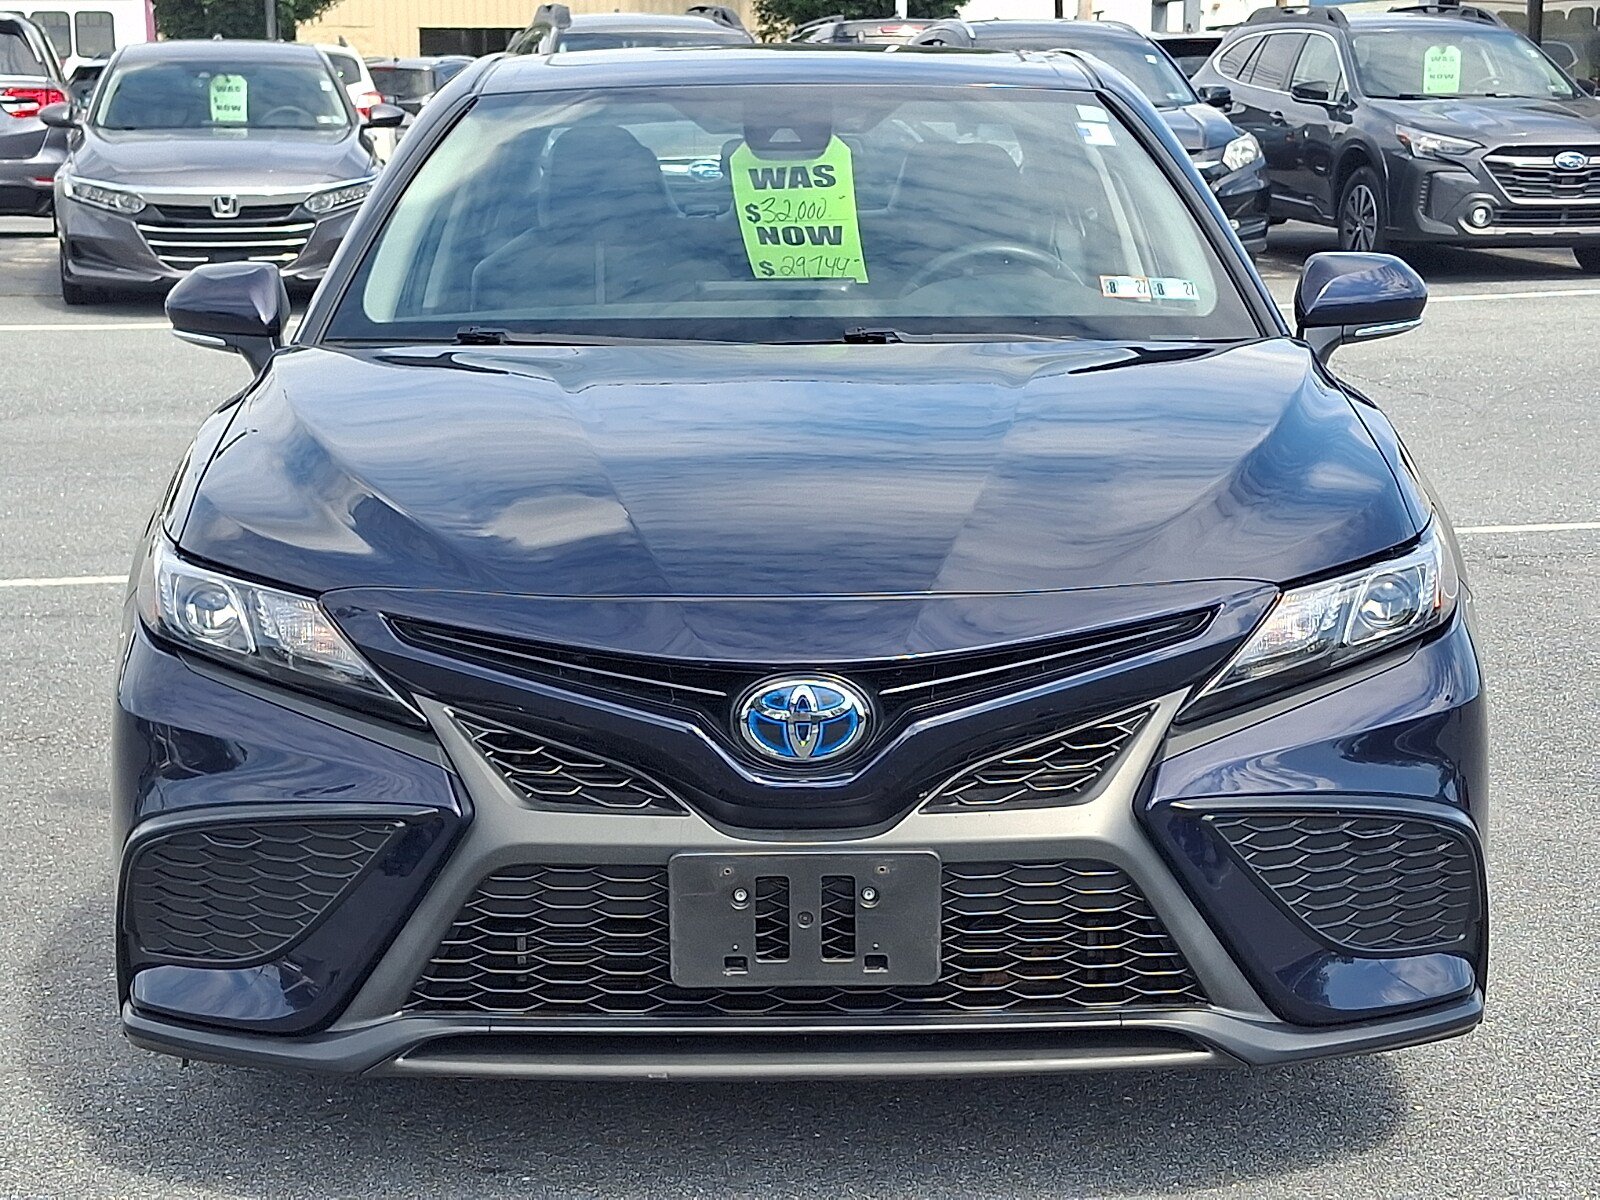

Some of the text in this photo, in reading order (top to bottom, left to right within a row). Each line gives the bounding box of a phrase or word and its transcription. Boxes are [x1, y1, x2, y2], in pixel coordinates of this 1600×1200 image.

[748, 165, 837, 190] WAS
[756, 225, 843, 246] NOW
[1183, 282, 1196, 296] 27
